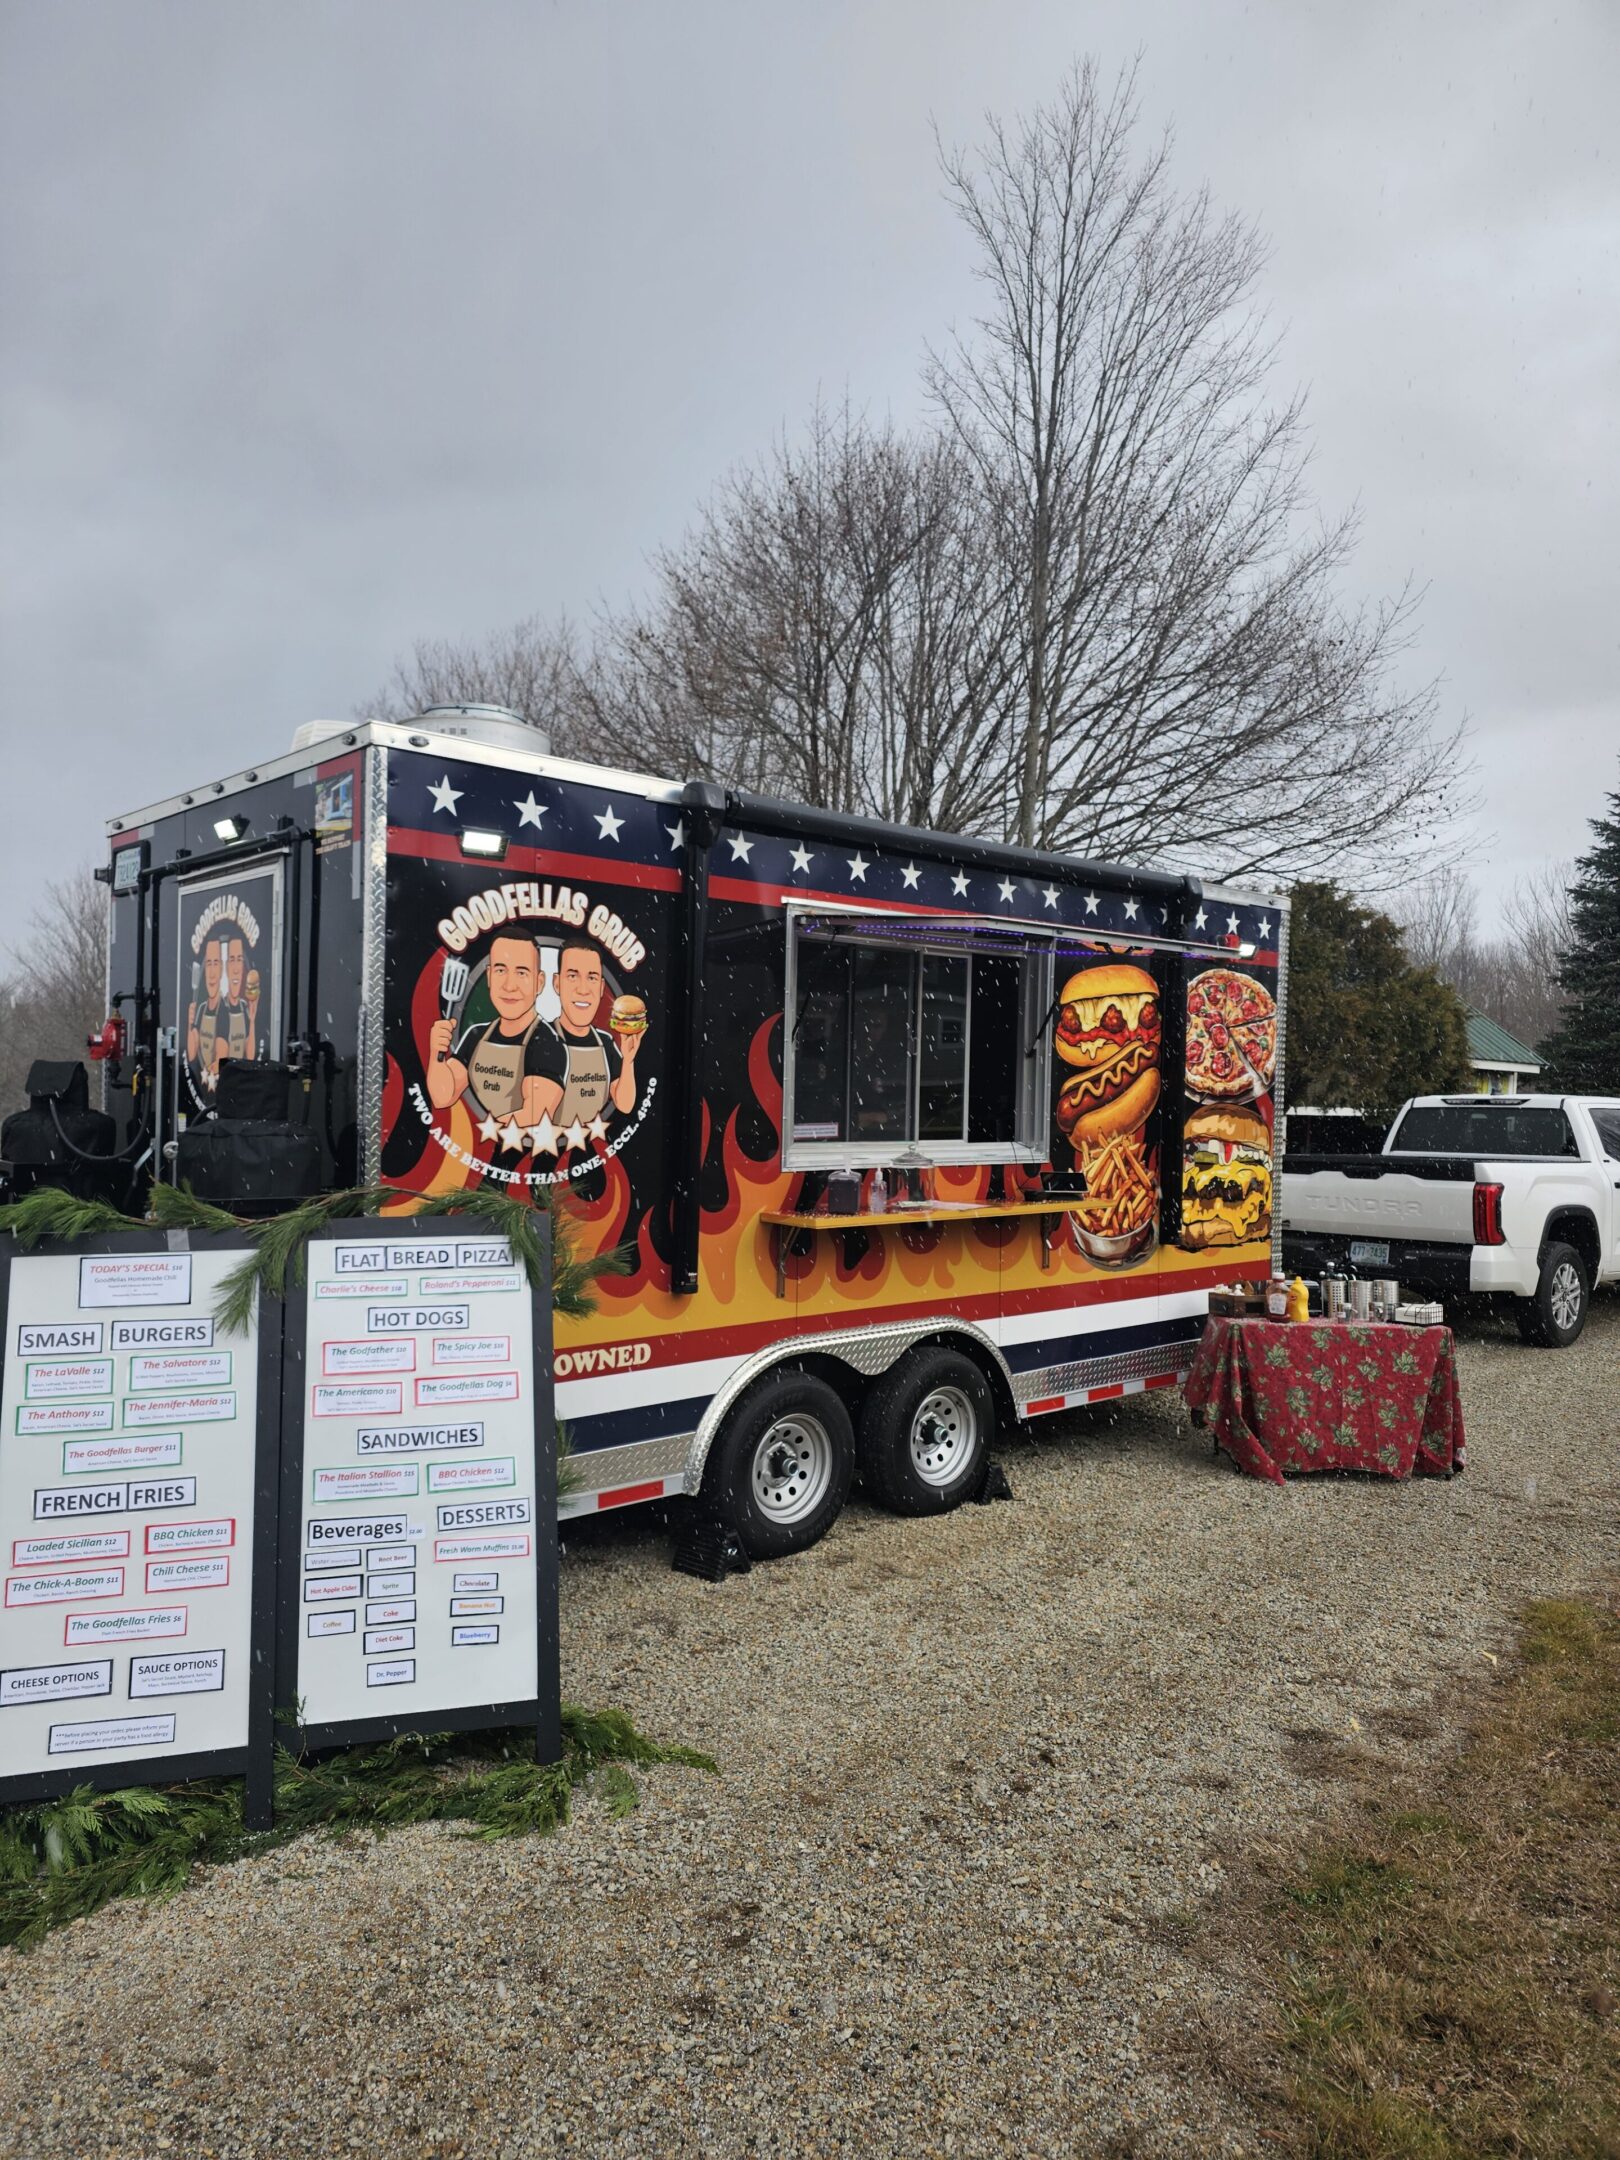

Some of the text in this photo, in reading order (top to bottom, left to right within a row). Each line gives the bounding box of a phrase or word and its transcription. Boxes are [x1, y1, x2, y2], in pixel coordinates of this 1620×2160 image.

[437, 882, 646, 970] GOODFELLAS GRUB
[483, 1080, 501, 1092] Grub
[580, 1088, 596, 1098] Grub
[408, 1083, 434, 1125] TWO
[429, 1127, 462, 1158] ARE
[460, 1152, 521, 1184] BETTER
[524, 1169, 569, 1185] THAN
[571, 1155, 607, 1177] ONE,
[604, 1122, 640, 1158] ECCL.
[1305, 1195, 1422, 1216] TUNDRA
[341, 1249, 509, 1268] FLAT BREAD PIZZA
[90, 1264, 130, 1273] TODAY'S
[132, 1263, 170, 1272] SPECIAL
[320, 1285, 357, 1294] Charlie's
[360, 1284, 389, 1292] Cheese
[424, 1280, 460, 1289] Roland's
[462, 1278, 505, 1288] Pepperoni
[374, 1311, 464, 1327] HOT DOGS
[23, 1325, 207, 1348] SMASH BURGERS
[331, 1348, 347, 1356] The
[349, 1346, 394, 1356] Godfather
[437, 1343, 454, 1351] The
[454, 1342, 477, 1351] Spicy
[477, 1342, 492, 1350] Joe
[143, 1360, 160, 1369] The
[162, 1359, 208, 1369] Salvatore
[553, 1343, 651, 1376] OWNED
[35, 1368, 53, 1377] The
[55, 1366, 91, 1376] LaValle
[318, 1389, 335, 1397] The
[336, 1387, 384, 1397] Americano
[422, 1384, 437, 1393] The
[439, 1381, 485, 1392] Goodfellas
[486, 1380, 504, 1389] Dog
[129, 1403, 147, 1412] The
[148, 1397, 218, 1410] Jennifer-Maria
[28, 1411, 46, 1420] The
[48, 1409, 91, 1420] Anthony
[361, 1428, 478, 1450] SANDWICHES
[69, 1451, 85, 1459] The
[87, 1447, 133, 1458] Goodfellas
[134, 1445, 163, 1455] Burger
[319, 1474, 336, 1482] The
[337, 1471, 367, 1482] Italian
[368, 1469, 402, 1479] Stallion
[438, 1470, 458, 1479] BBQ
[460, 1467, 492, 1477] Chicken
[42, 1485, 185, 1513] FRENCH FRIES
[442, 1503, 526, 1526] DESSERTS
[153, 1531, 175, 1541] BBQ
[177, 1528, 214, 1539] Chicken
[312, 1521, 403, 1540] Beverages
[27, 1541, 64, 1553] Loaded
[66, 1538, 102, 1549] Sicilian
[439, 1547, 459, 1555] Fresh
[483, 1544, 509, 1552] Muffins
[393, 1554, 408, 1562] Beer
[152, 1566, 174, 1577] Chili
[176, 1564, 210, 1574] Cheese
[12, 1583, 31, 1592] The
[34, 1577, 104, 1590] Chick-A-Boom
[323, 1586, 340, 1594] Apple
[381, 1582, 399, 1591] Sprite
[71, 1622, 90, 1631] The
[92, 1617, 145, 1629] Goodfellas
[148, 1615, 171, 1624] Fries
[375, 1636, 389, 1644] Diet
[459, 1632, 491, 1640] Blueberry
[138, 1659, 218, 1675] SAUCE OPTIONS
[11, 1671, 100, 1690] CHEESE OPTIONS
[385, 1669, 408, 1679] Pepper
